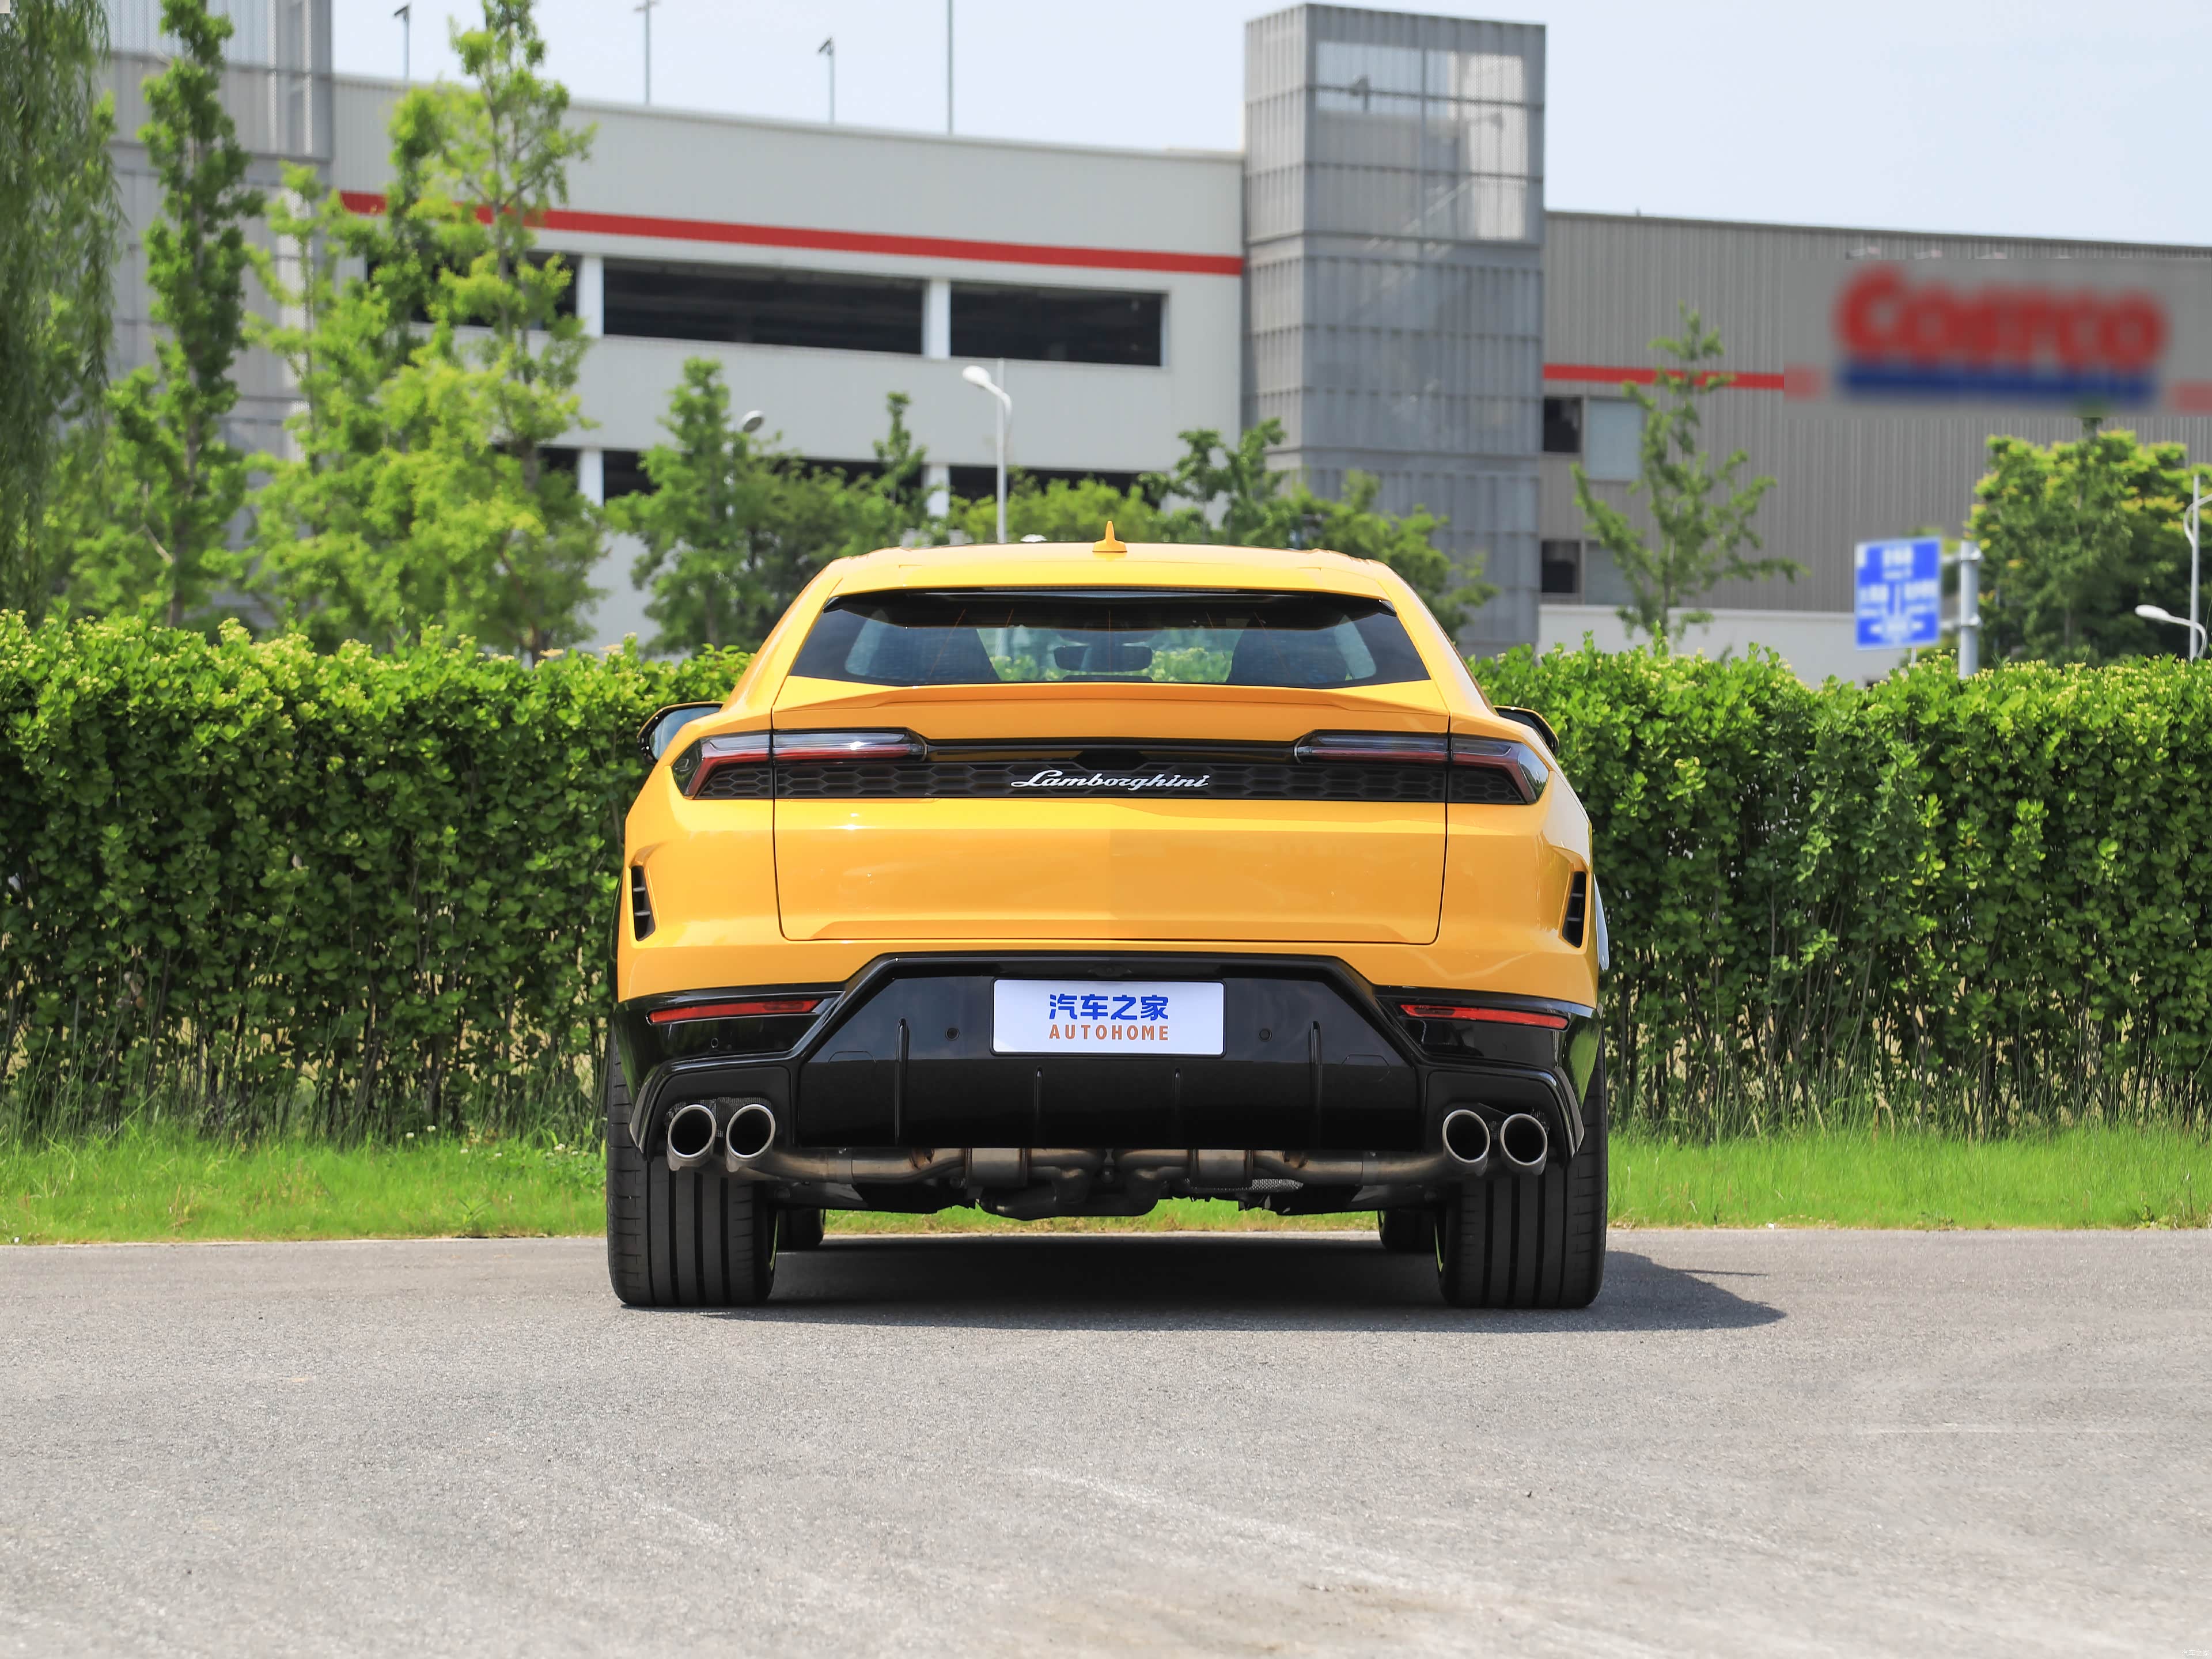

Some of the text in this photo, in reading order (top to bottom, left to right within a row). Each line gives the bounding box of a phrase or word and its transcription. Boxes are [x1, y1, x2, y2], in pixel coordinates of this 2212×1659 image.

[1011, 770, 1210, 791] Lamborghini
[1049, 994, 1169, 1020] 汽车之家
[1049, 1024, 1168, 1040] AUTOHOME
